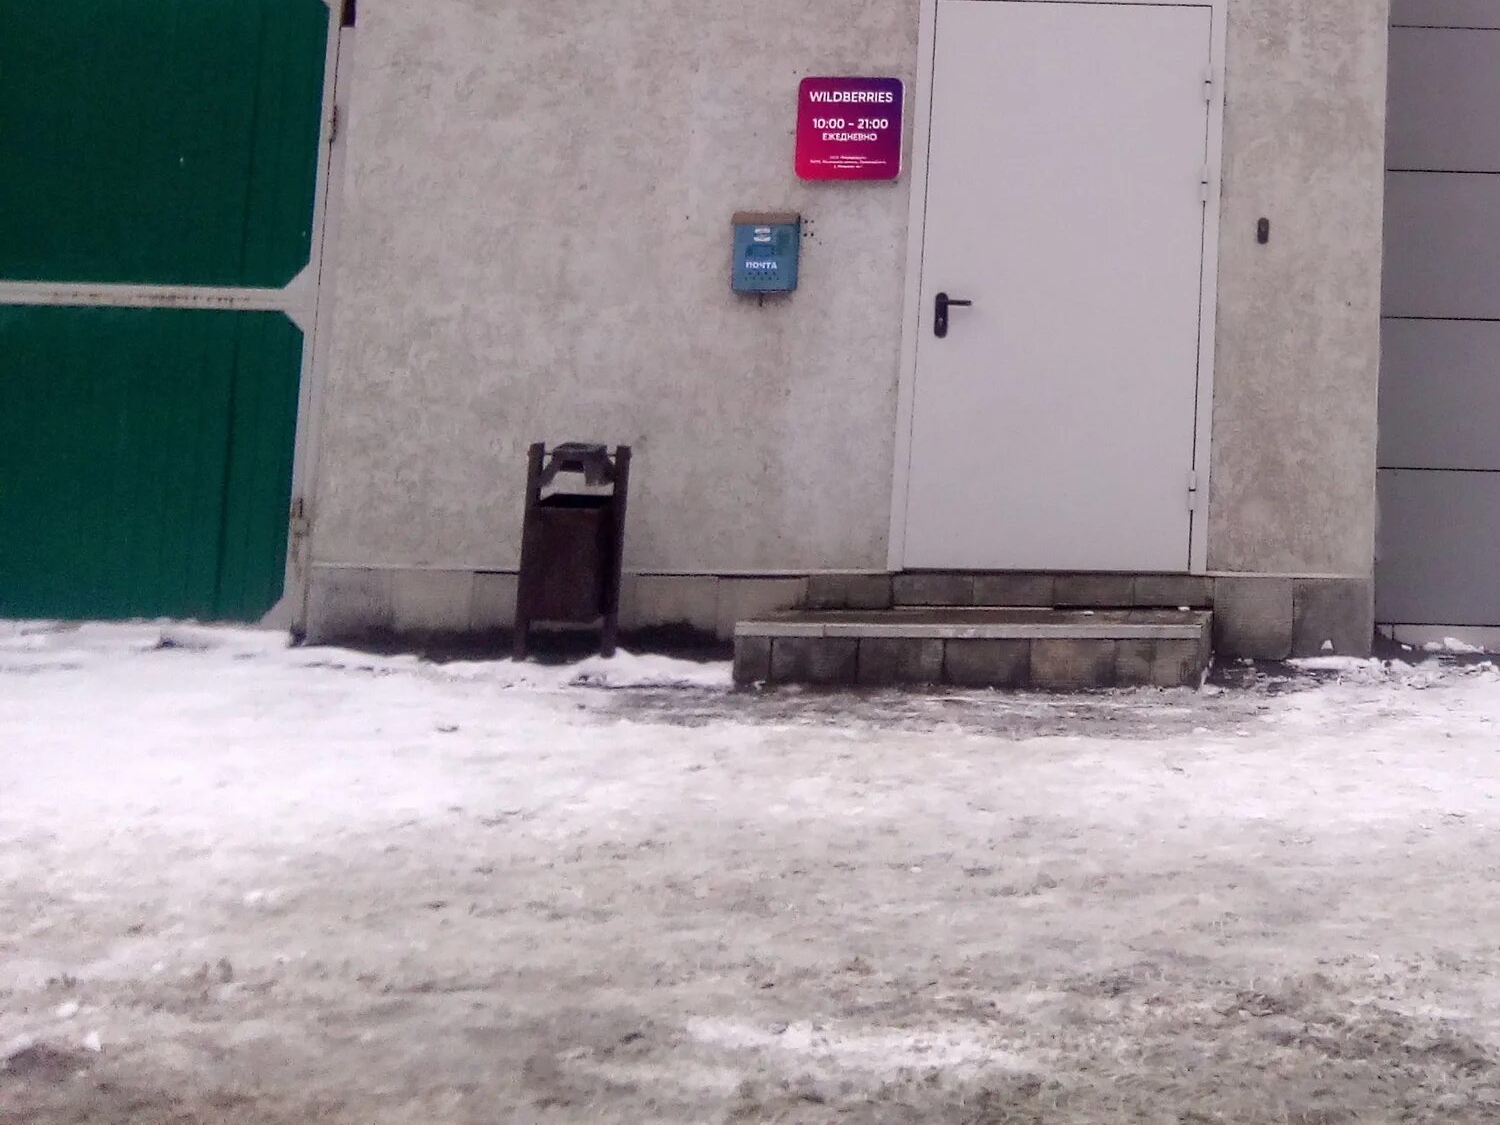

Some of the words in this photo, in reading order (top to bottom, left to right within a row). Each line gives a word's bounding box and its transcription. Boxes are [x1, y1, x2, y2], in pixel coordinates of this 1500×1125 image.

[809, 90, 894, 104] WILDBERRIES
[812, 118, 845, 130] 10:00
[857, 118, 889, 130] 21:00
[822, 132, 878, 142] ЕЖЕДНЕВНО
